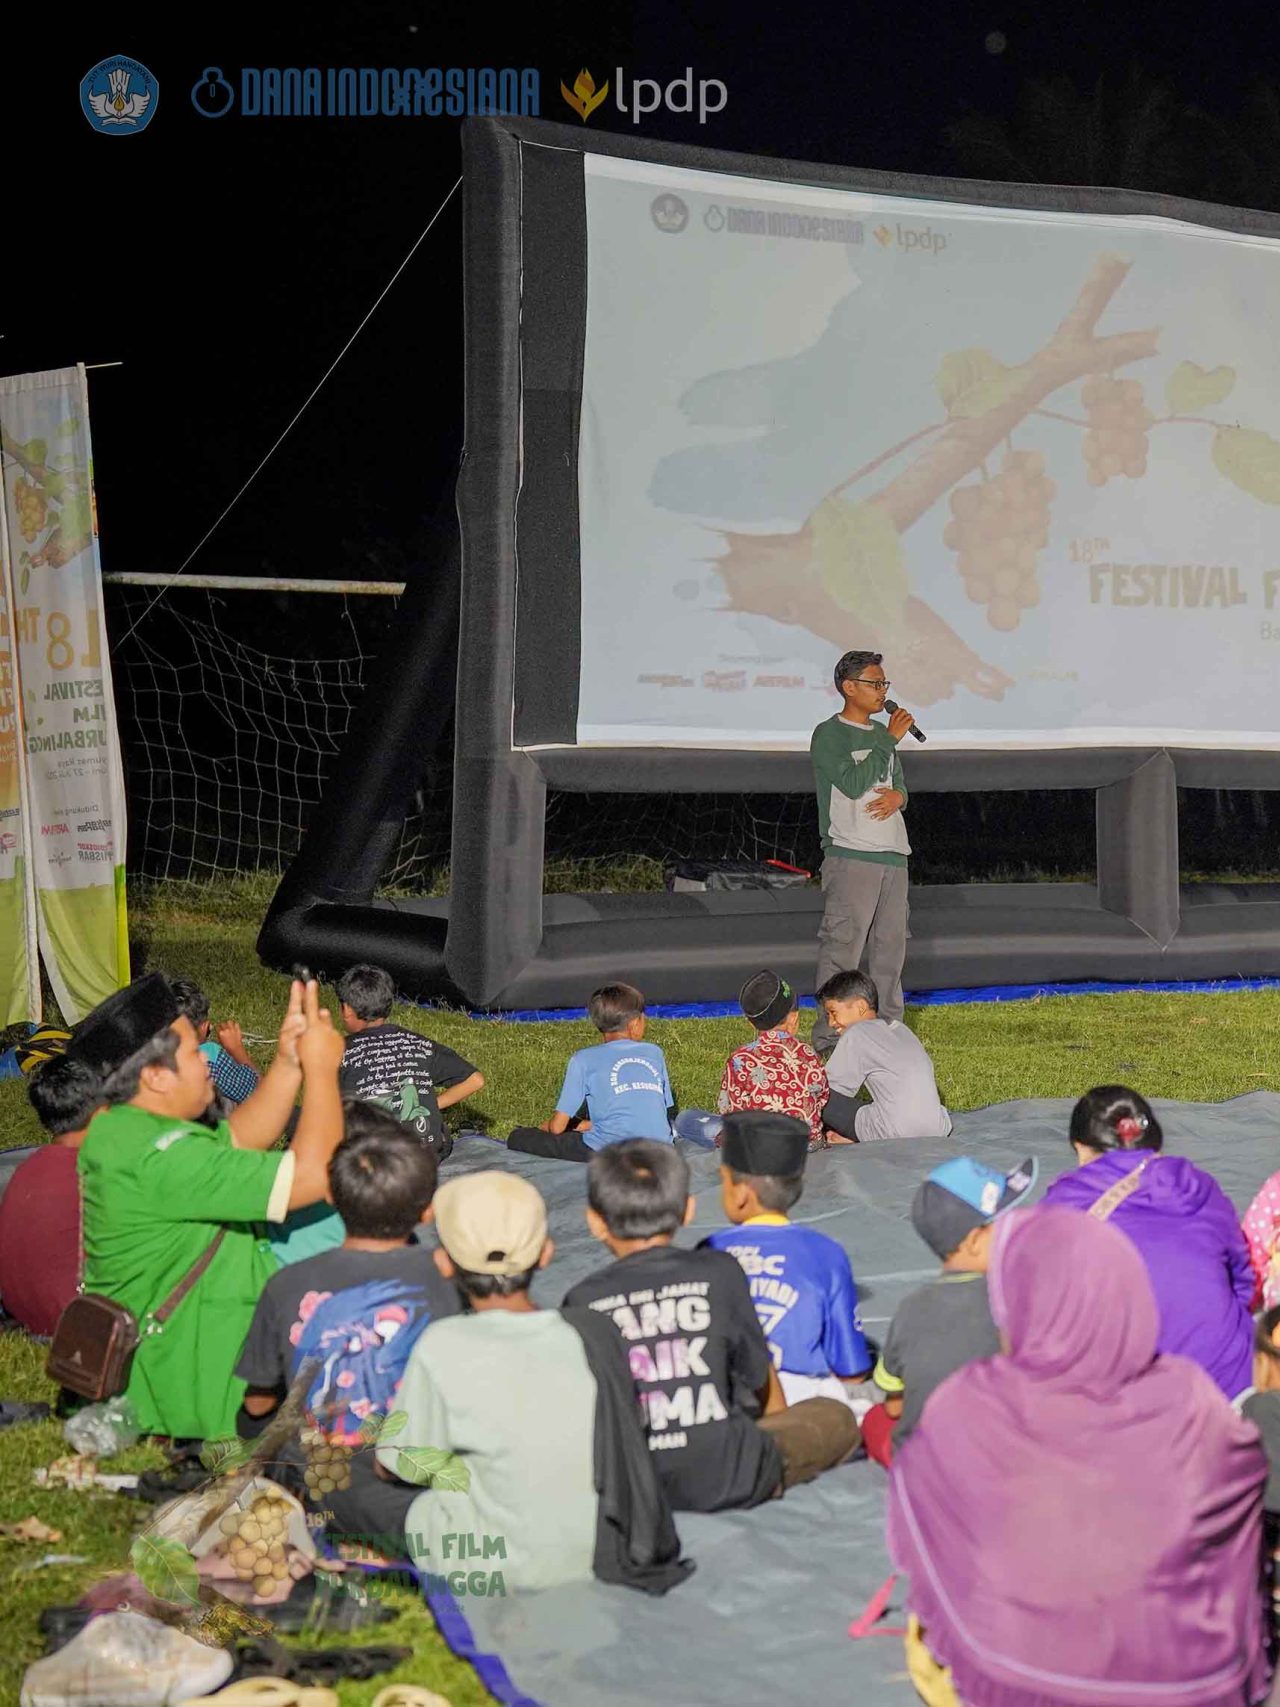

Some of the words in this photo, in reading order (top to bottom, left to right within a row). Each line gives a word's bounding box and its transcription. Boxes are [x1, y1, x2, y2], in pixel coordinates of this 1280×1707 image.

[896, 224, 947, 254] lpdp
[1089, 562, 1247, 609] FESTIVAL
[612, 1296, 711, 1340] ANG
[628, 1336, 711, 1382] AIK
[640, 1382, 728, 1431] MA
